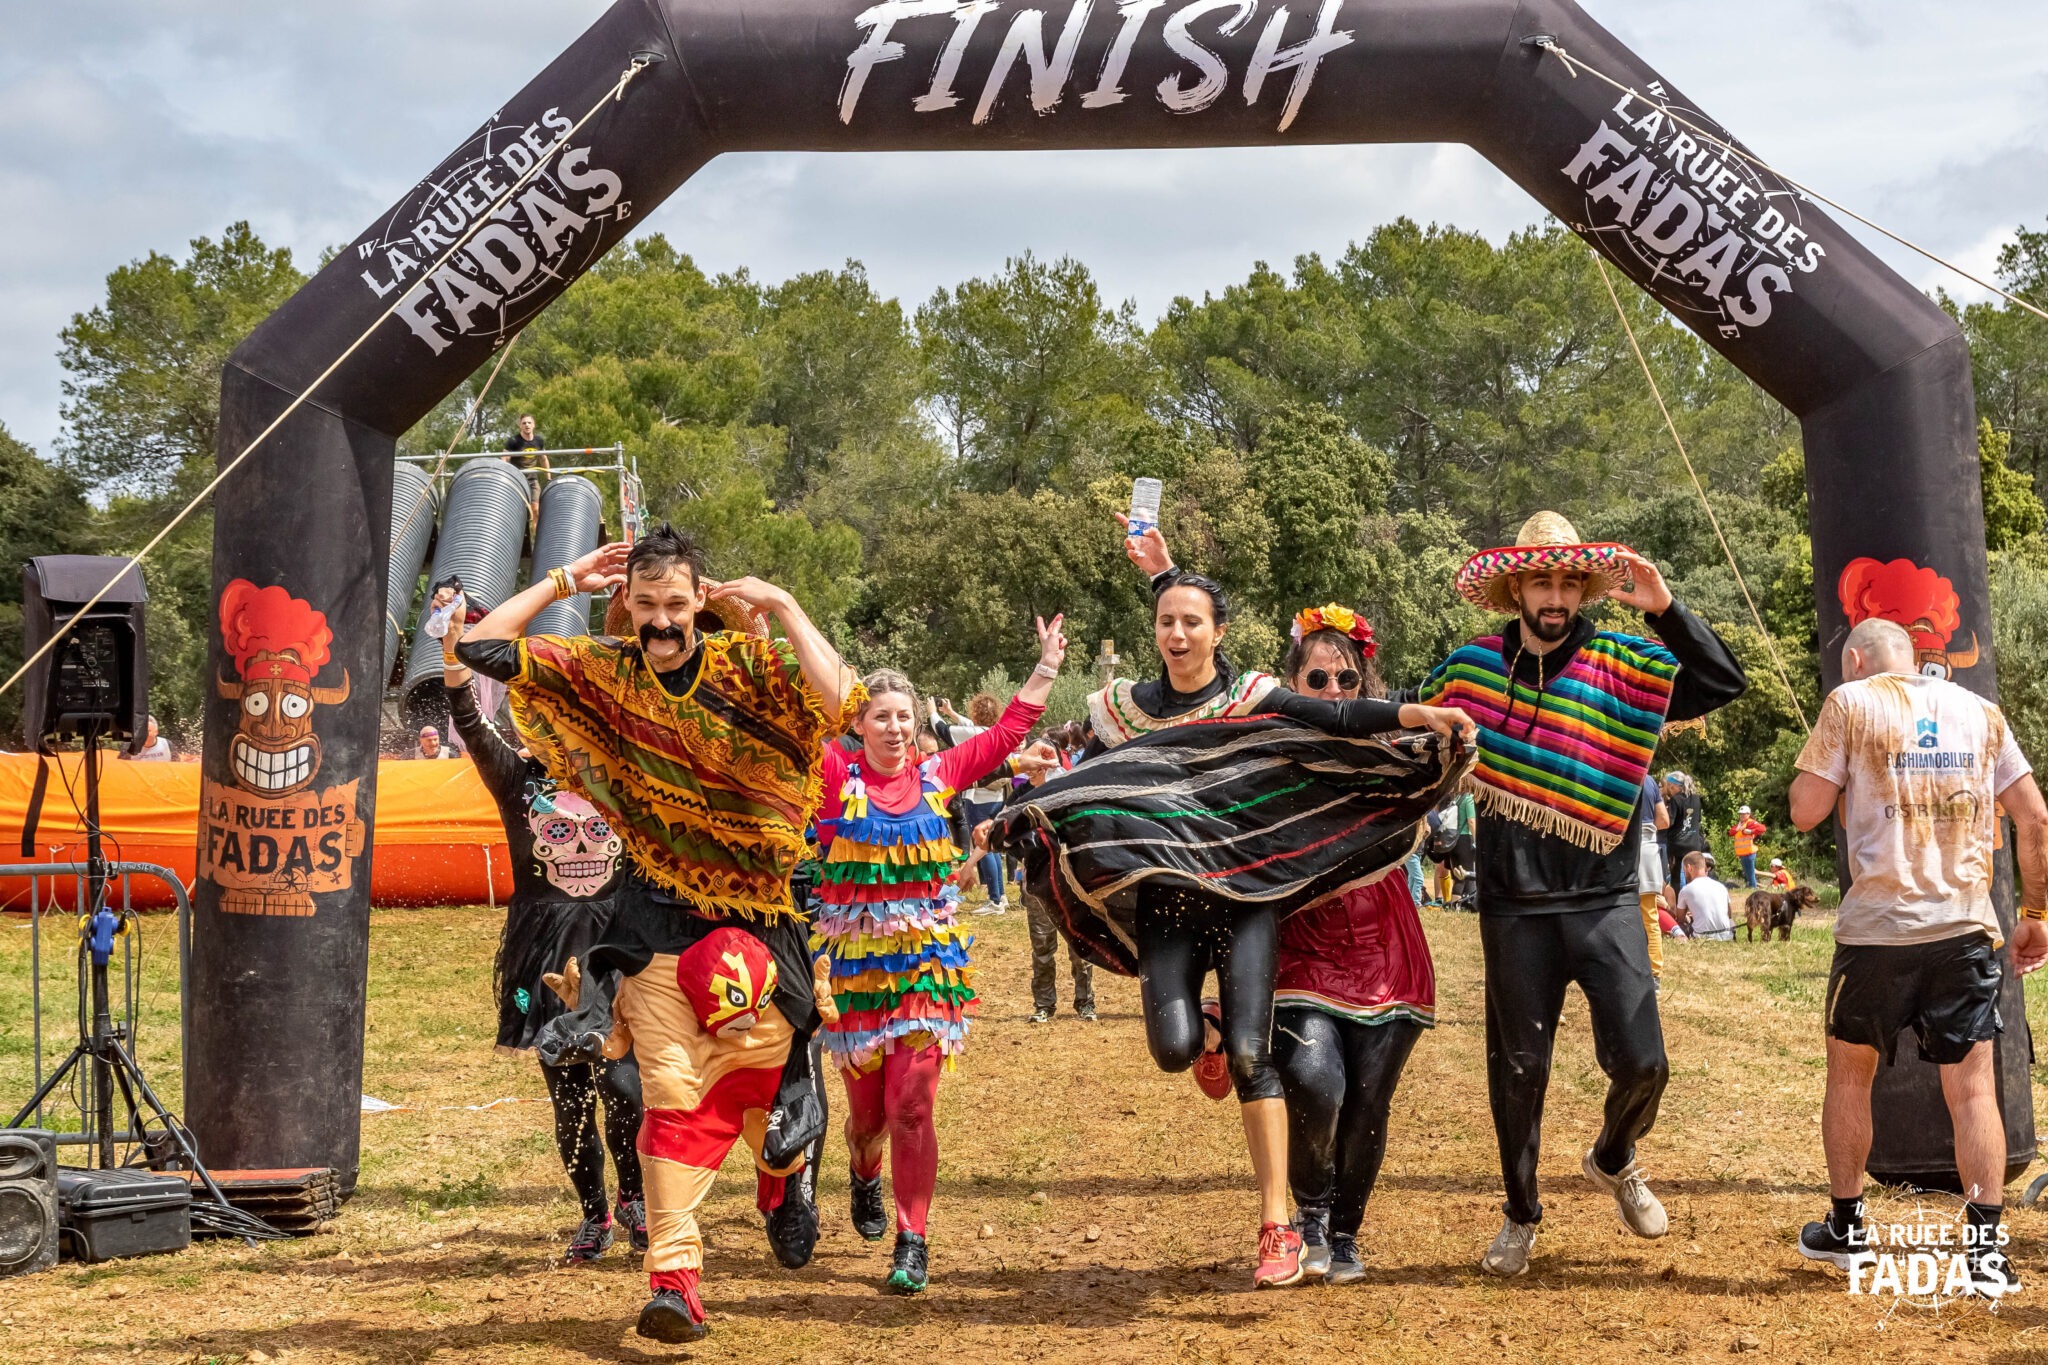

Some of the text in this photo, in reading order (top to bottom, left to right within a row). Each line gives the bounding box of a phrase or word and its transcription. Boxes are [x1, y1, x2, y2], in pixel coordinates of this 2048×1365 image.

[837, 0, 1355, 132] FINISH
[360, 106, 573, 300] LA RUEE DES
[393, 146, 622, 357] FADAS
[1560, 119, 1793, 328] FADAS
[1612, 87, 1827, 274] LA RUEE DES
[207, 823, 343, 875] FADAS
[208, 796, 346, 830] LA RUEE DES
